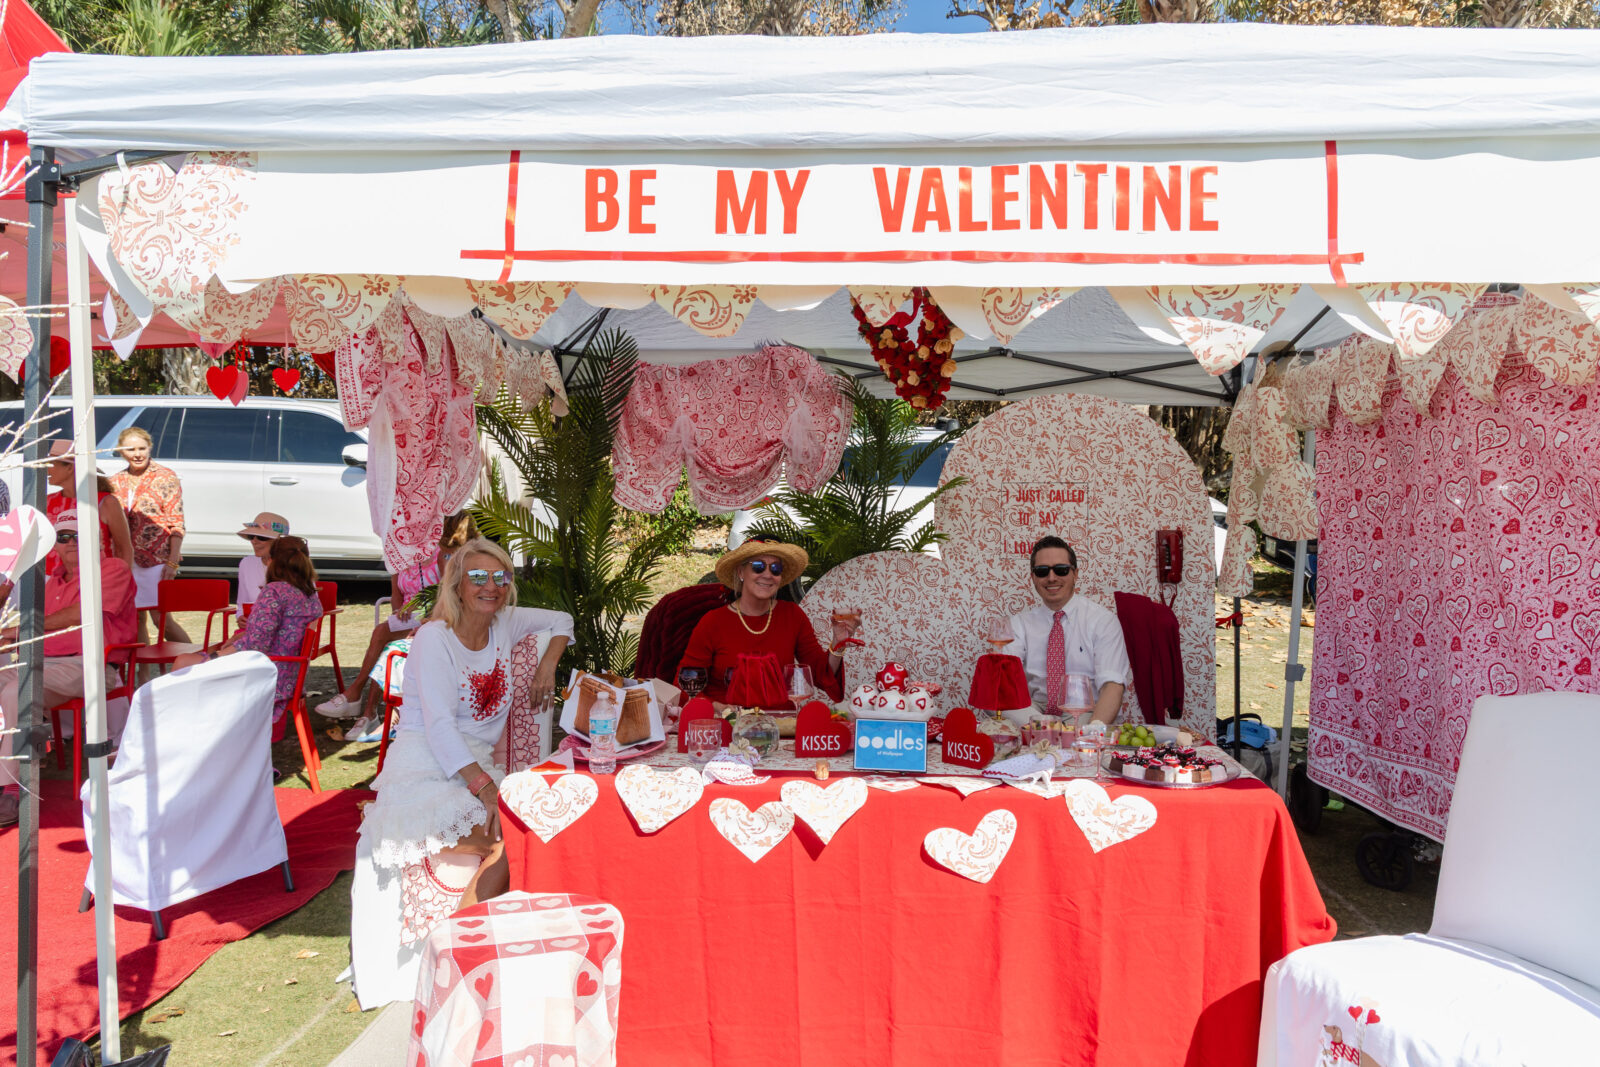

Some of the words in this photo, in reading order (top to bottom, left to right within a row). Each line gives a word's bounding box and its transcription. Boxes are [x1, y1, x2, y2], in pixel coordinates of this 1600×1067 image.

[585, 168, 657, 234] BE
[715, 169, 811, 235] MY
[872, 163, 1219, 233] VALENTINE
[1005, 488, 1010, 504] I
[1016, 489, 1041, 503] JUST
[1049, 489, 1085, 503] CALLED
[1018, 511, 1030, 526] TO
[1039, 511, 1058, 525] SAY
[1014, 540, 1037, 555] LOV
[684, 729, 722, 746] KISSES
[801, 735, 841, 751] KISSES
[857, 728, 924, 751] oodles
[947, 740, 981, 763] KISSES
